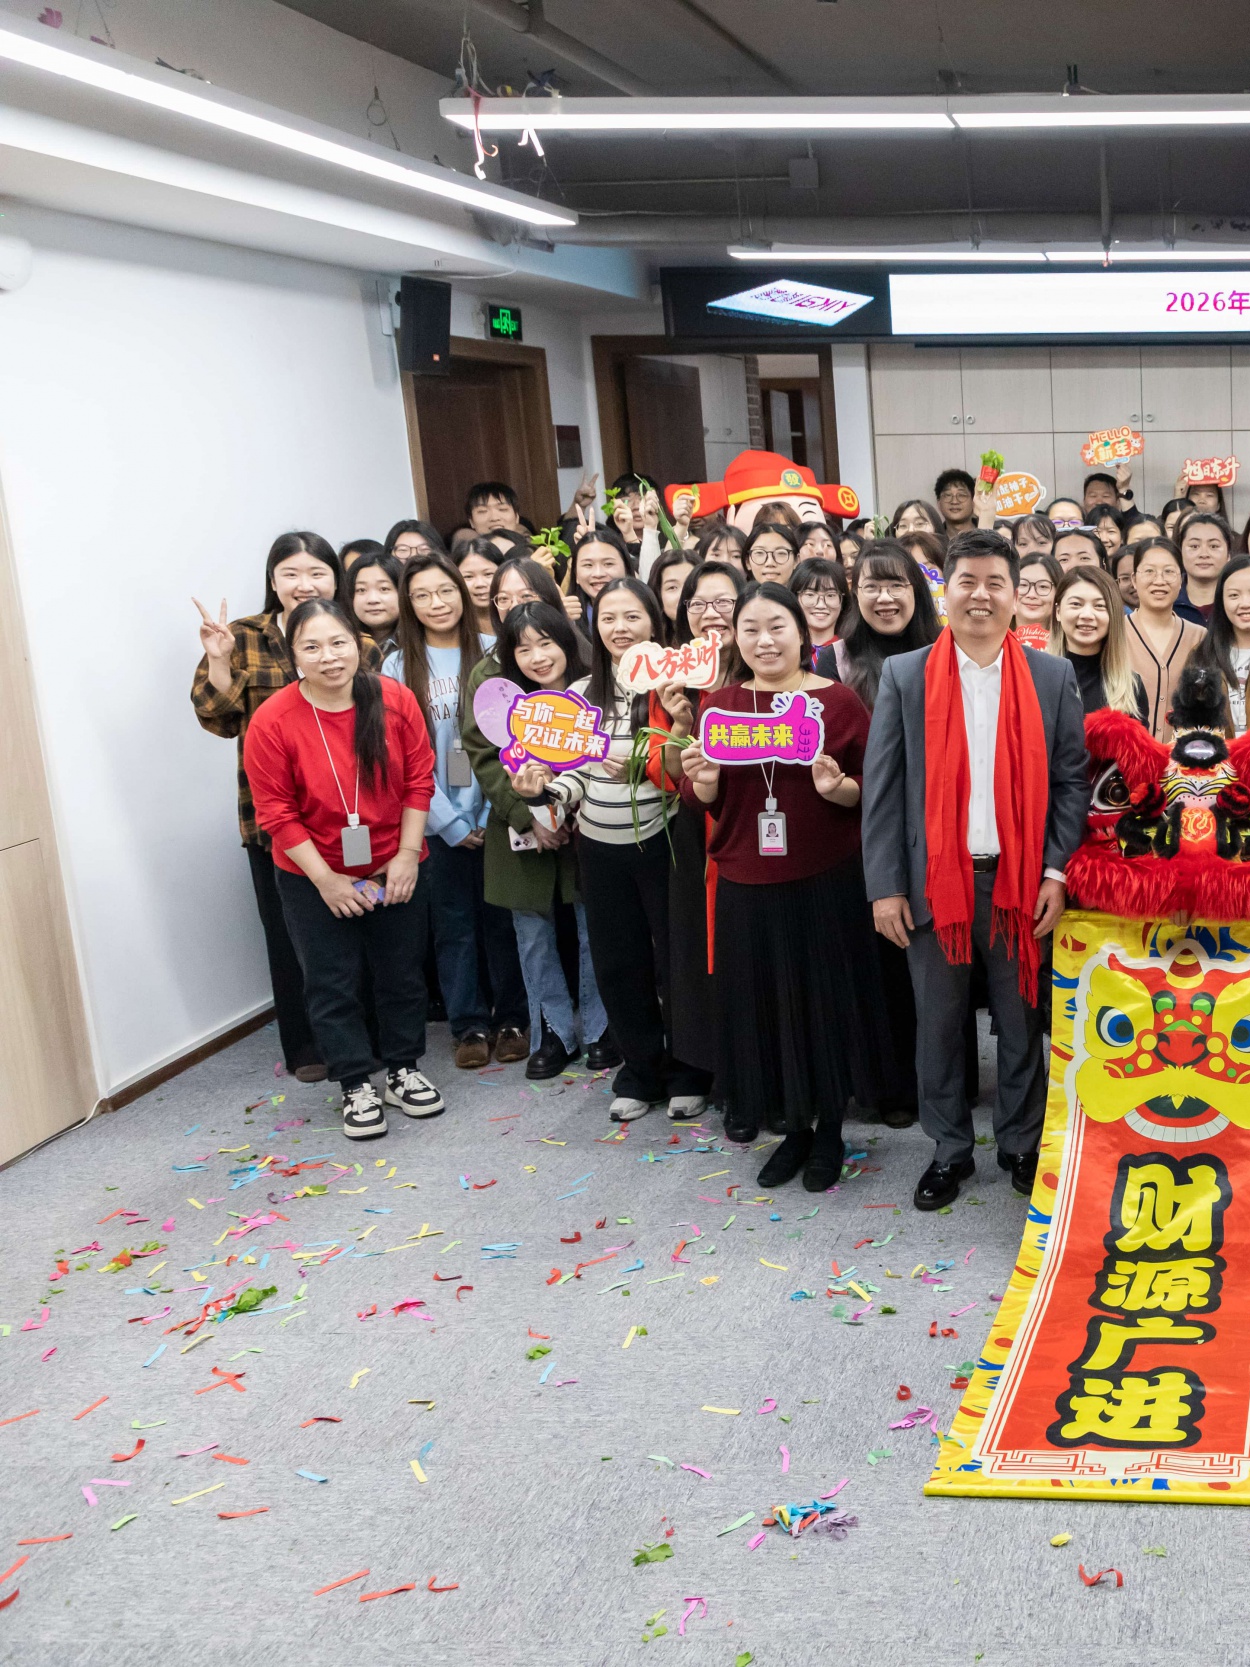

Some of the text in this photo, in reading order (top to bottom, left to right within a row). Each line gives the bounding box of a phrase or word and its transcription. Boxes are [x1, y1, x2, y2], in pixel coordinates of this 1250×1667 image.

[1089, 427, 1130, 444] HELLO
[1097, 442, 1130, 461] 新年
[1183, 456, 1240, 486] 旭日东升
[629, 632, 719, 686] 八方来财
[512, 698, 598, 731] 与你一起
[521, 723, 606, 757] 见证未来
[708, 723, 794, 748] 共赢未来
[1053, 1157, 1228, 1446] 财源广进
